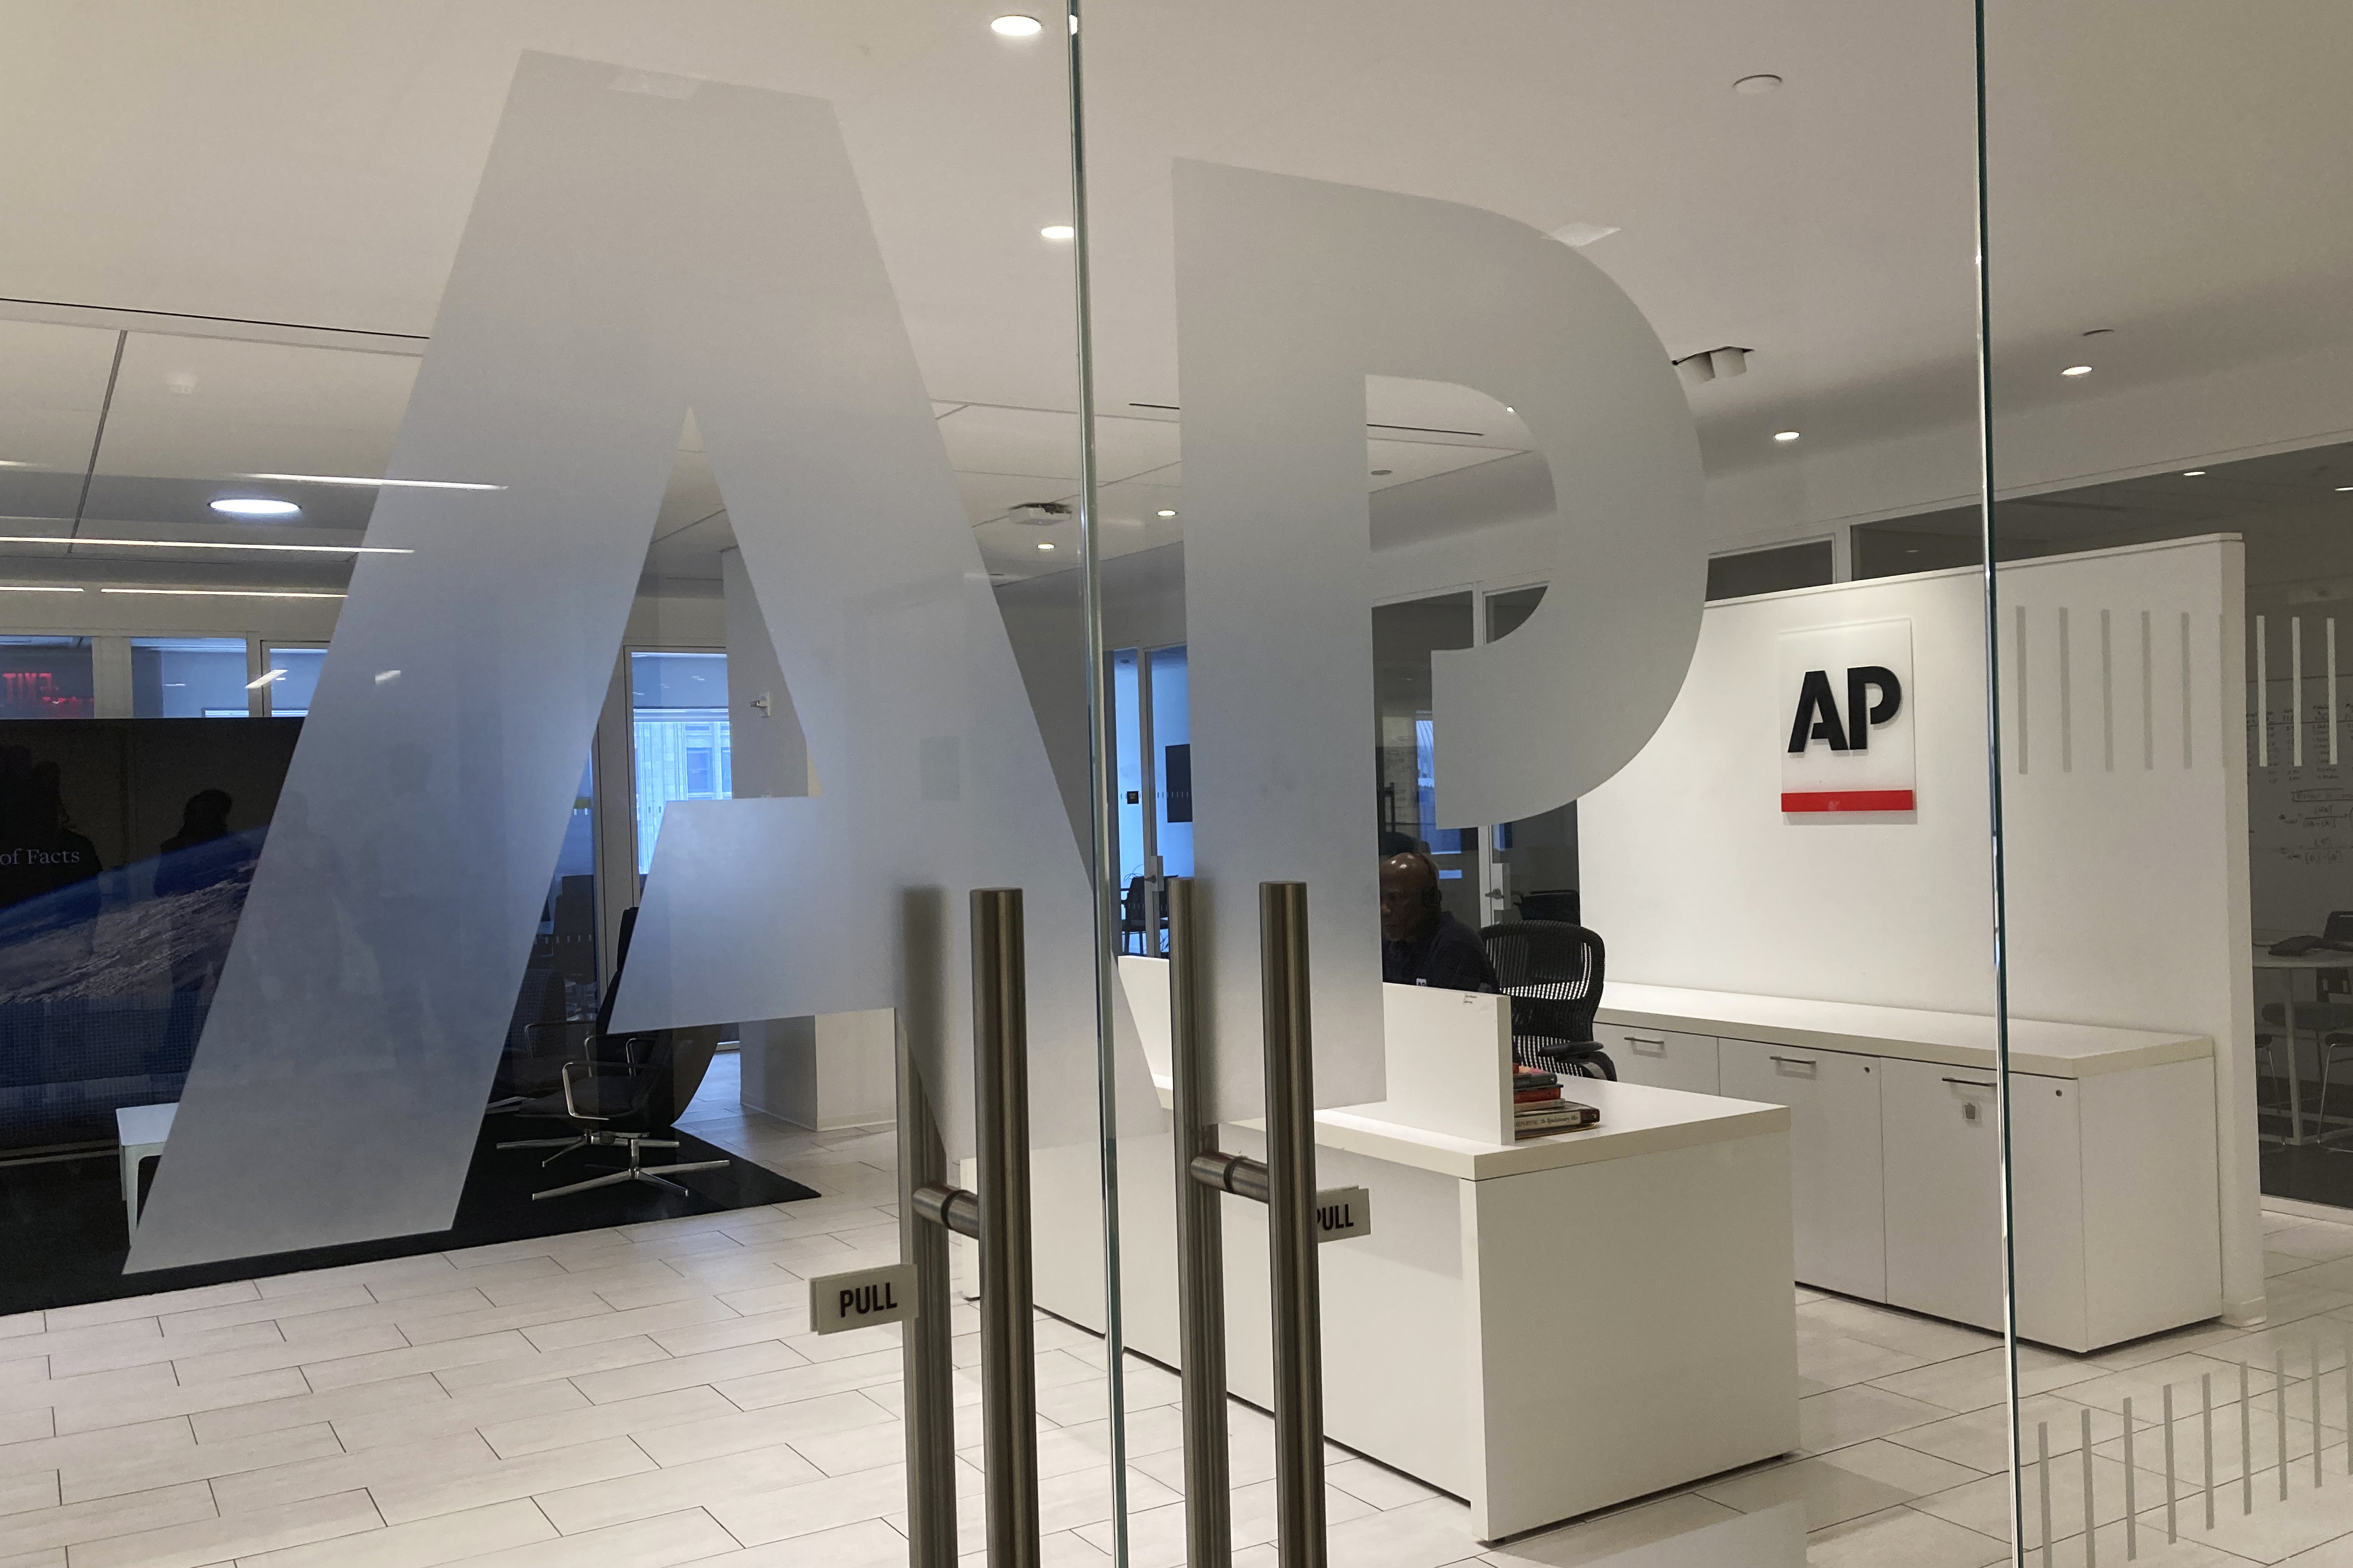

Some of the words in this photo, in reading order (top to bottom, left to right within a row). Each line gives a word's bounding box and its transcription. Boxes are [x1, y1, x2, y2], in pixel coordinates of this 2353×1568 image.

[122, 49, 1709, 1275] AP
[1788, 666, 1902, 753] AP
[0, 848, 22, 865] of
[26, 849, 80, 864] Facts
[840, 1282, 898, 1317] PULL
